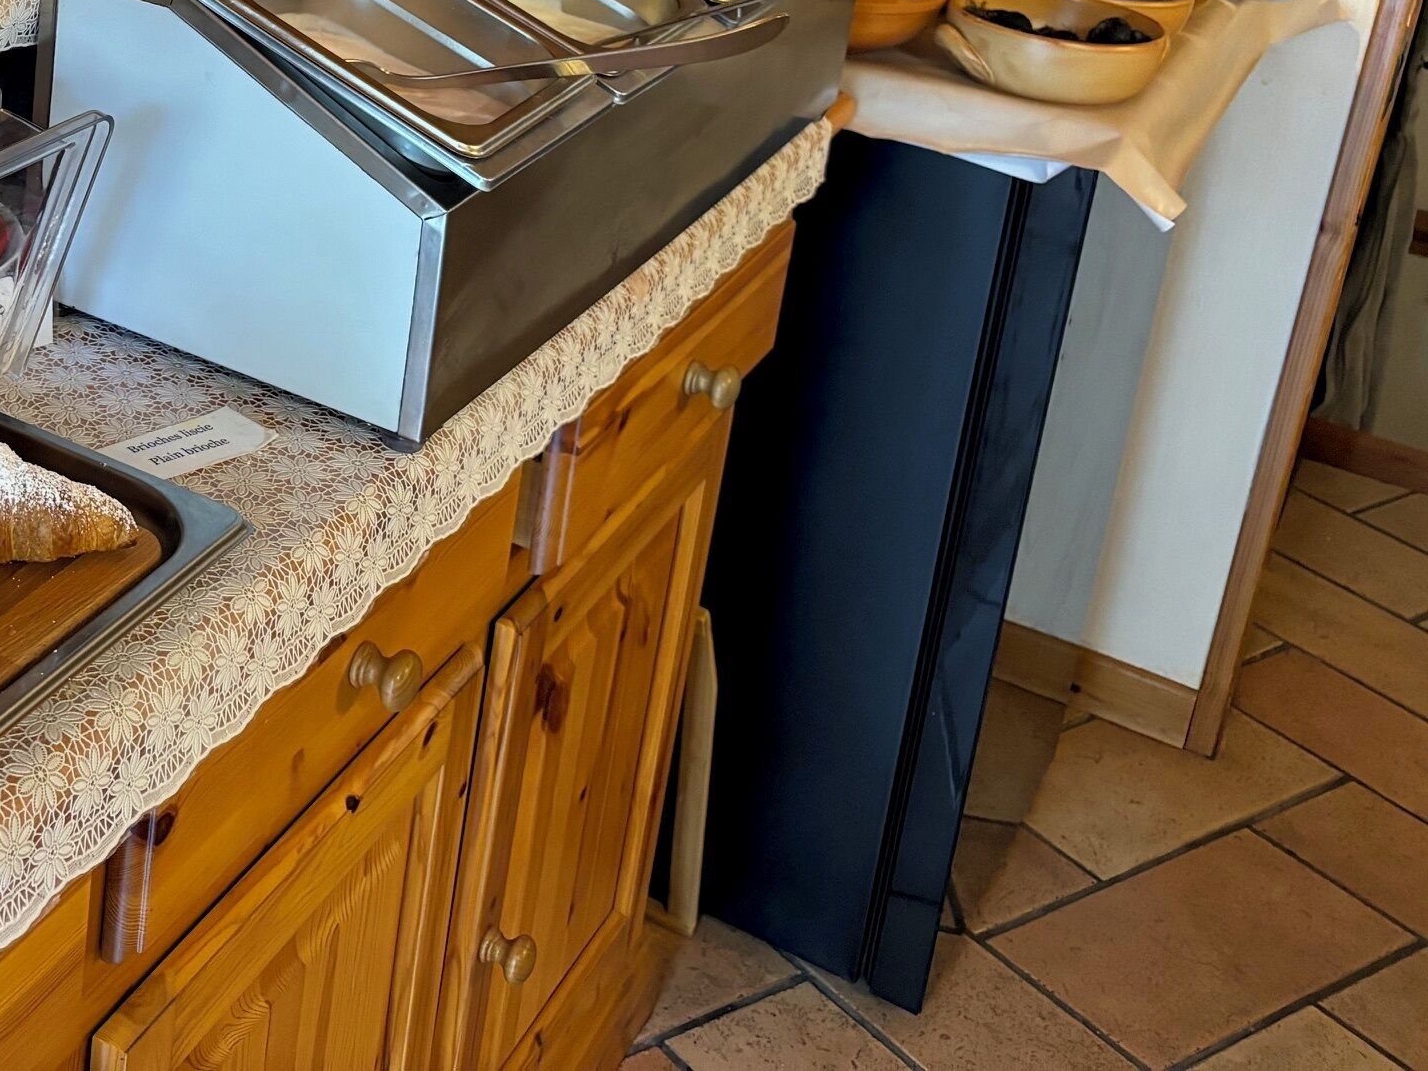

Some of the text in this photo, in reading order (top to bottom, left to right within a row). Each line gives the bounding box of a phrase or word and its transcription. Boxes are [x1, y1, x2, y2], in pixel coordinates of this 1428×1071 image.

[127, 423, 214, 454] Brioches liscie
[148, 436, 230, 466] Plain brioche
